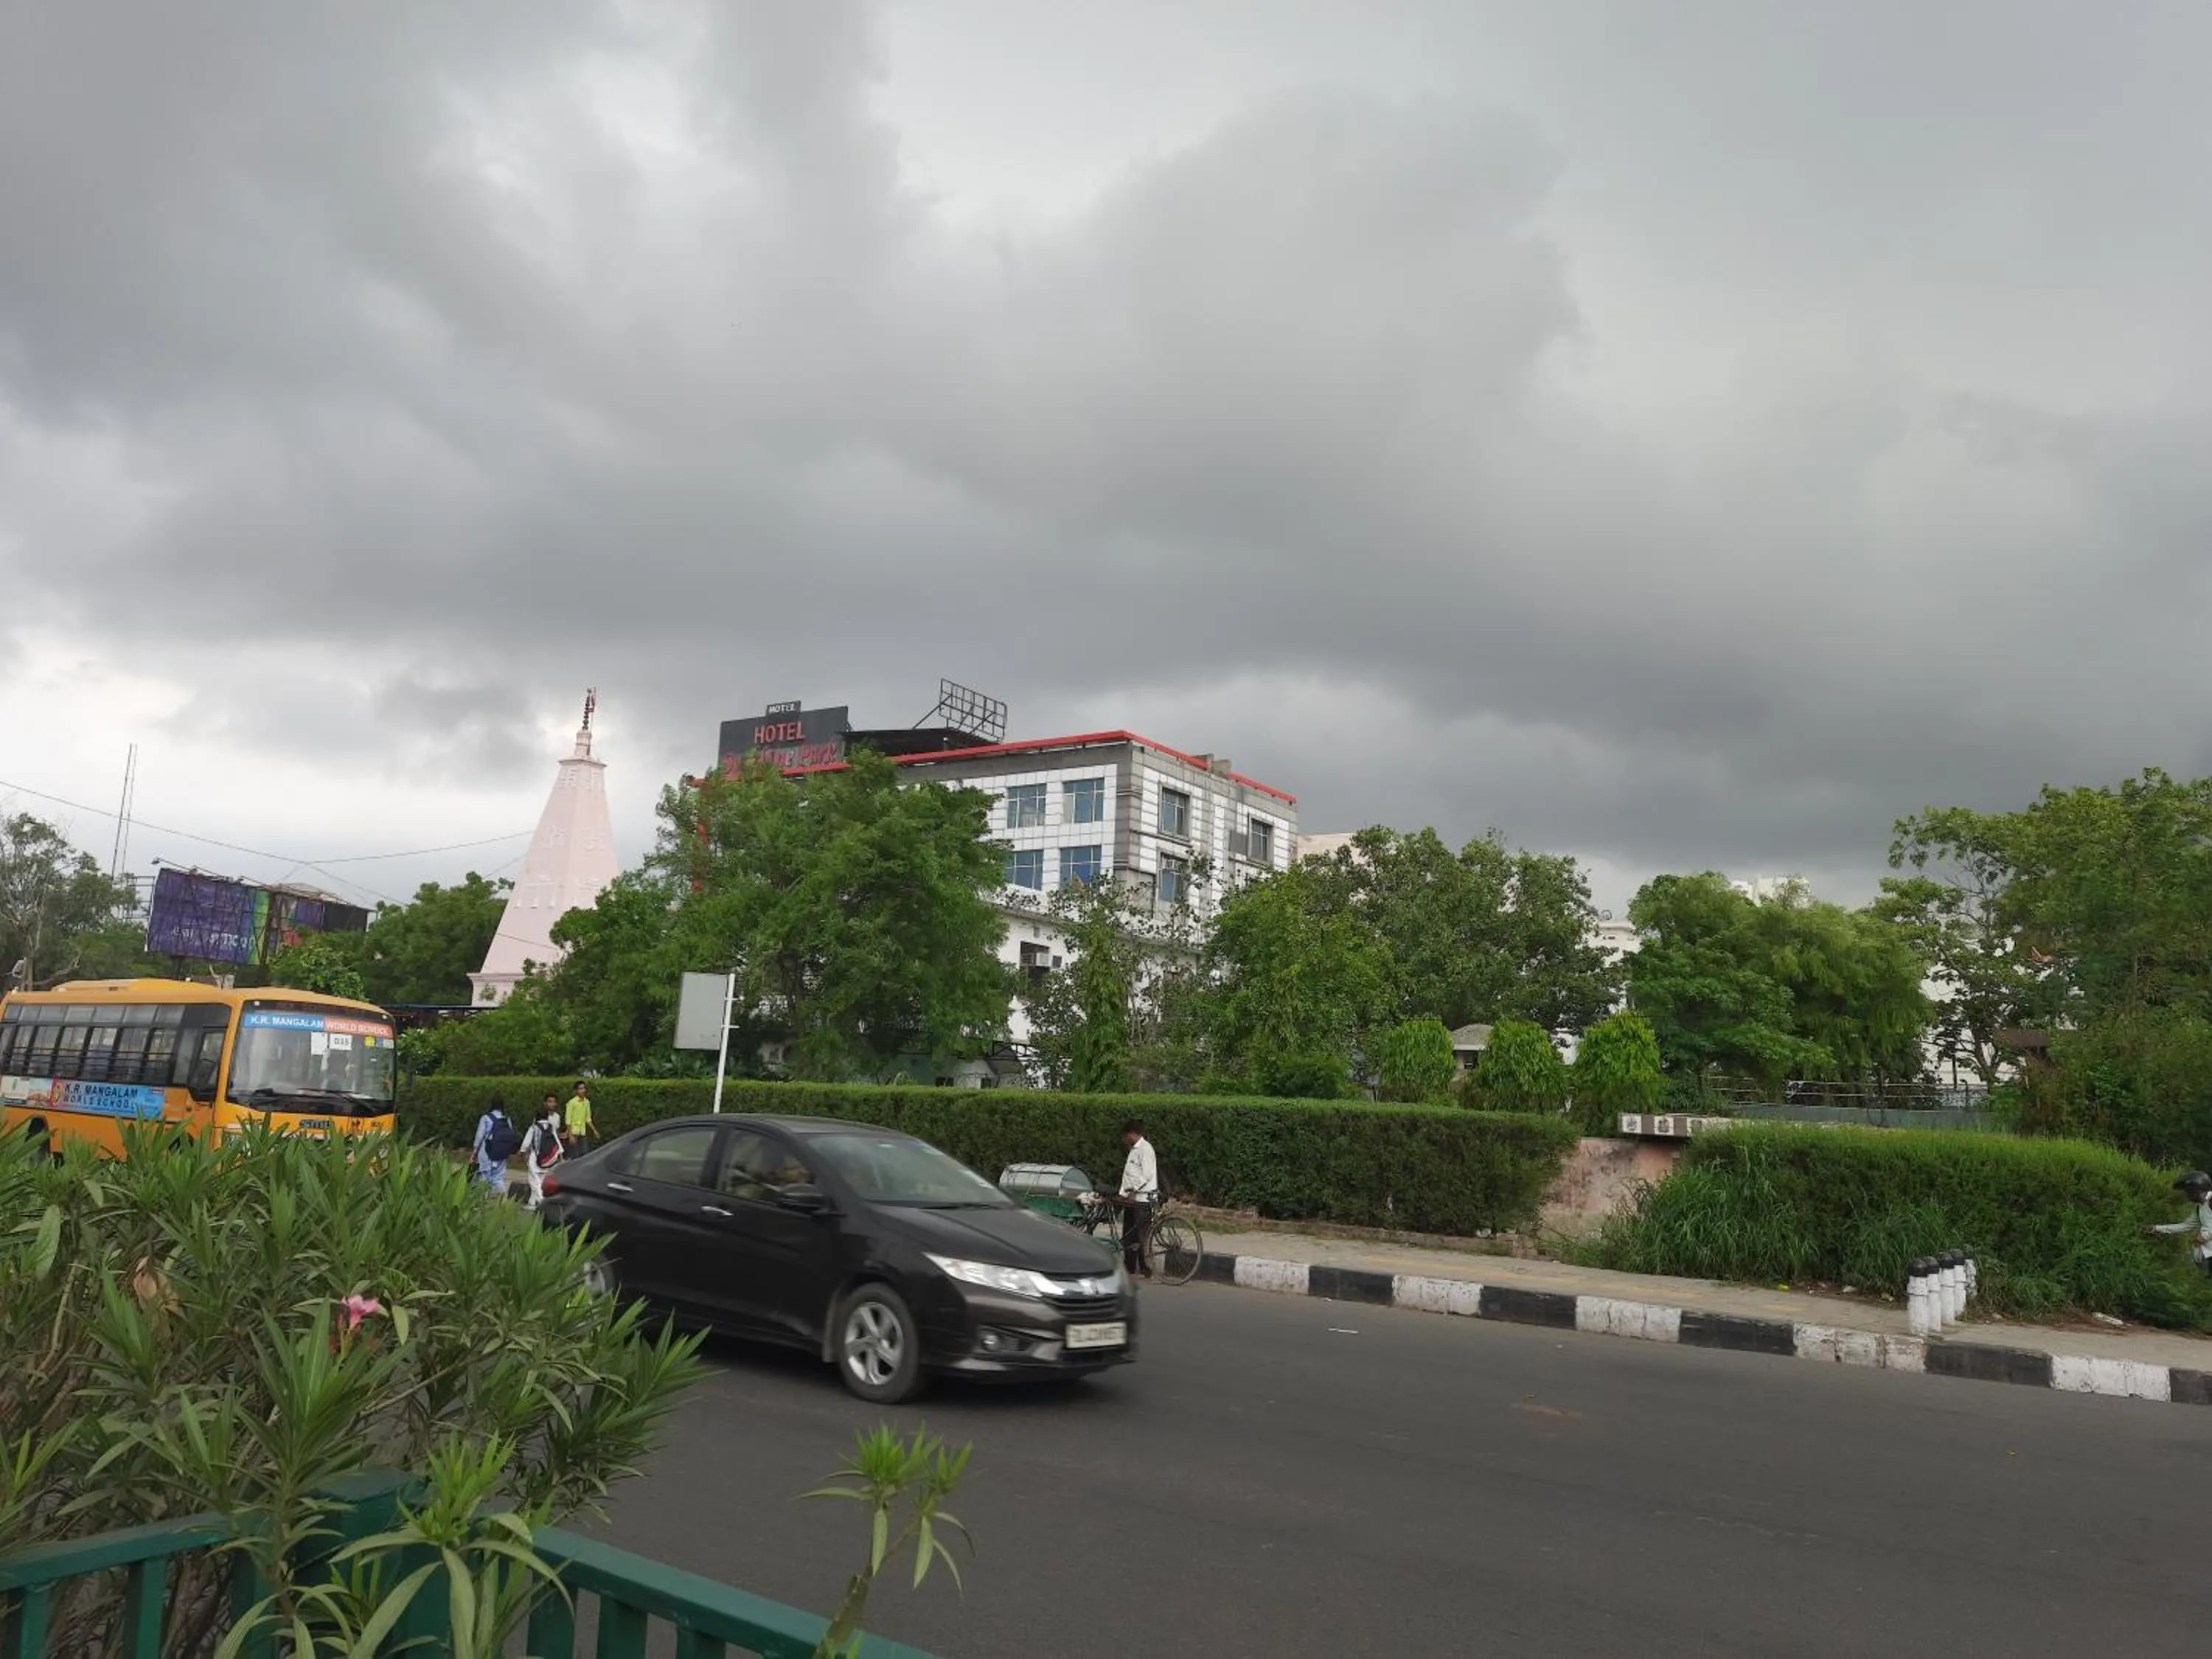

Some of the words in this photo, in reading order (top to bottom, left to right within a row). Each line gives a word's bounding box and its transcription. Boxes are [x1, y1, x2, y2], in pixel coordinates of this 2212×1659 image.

[754, 721, 806, 744] HOTEL
[251, 1016, 269, 1024] K.R.
[272, 1016, 324, 1029] MANGALAM
[65, 1084, 82, 1093] K.R.
[85, 1085, 139, 1097] MANGALAM
